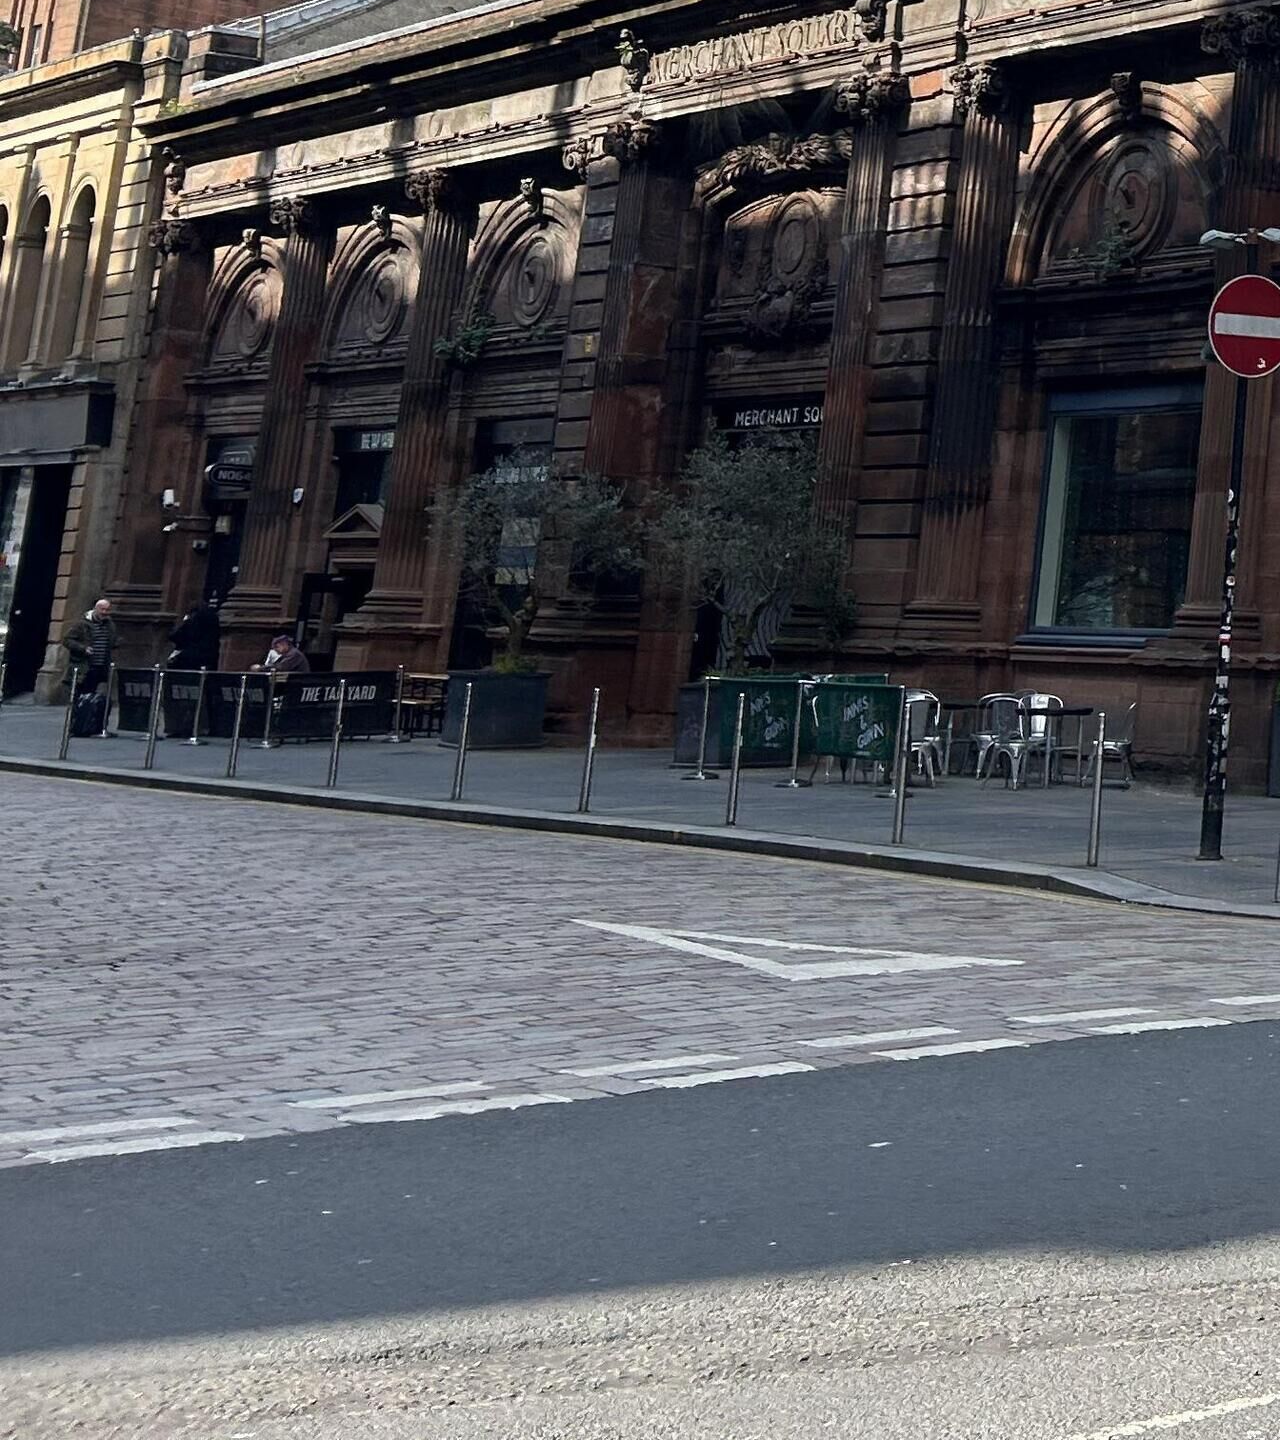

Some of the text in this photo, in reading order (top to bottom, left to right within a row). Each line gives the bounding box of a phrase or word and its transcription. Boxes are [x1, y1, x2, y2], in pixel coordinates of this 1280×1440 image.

[645, 10, 862, 84] MERCHANT SQUARE
[734, 408, 800, 427] MERCHANT
[301, 686, 320, 703] THE
[347, 684, 377, 701] YARD
